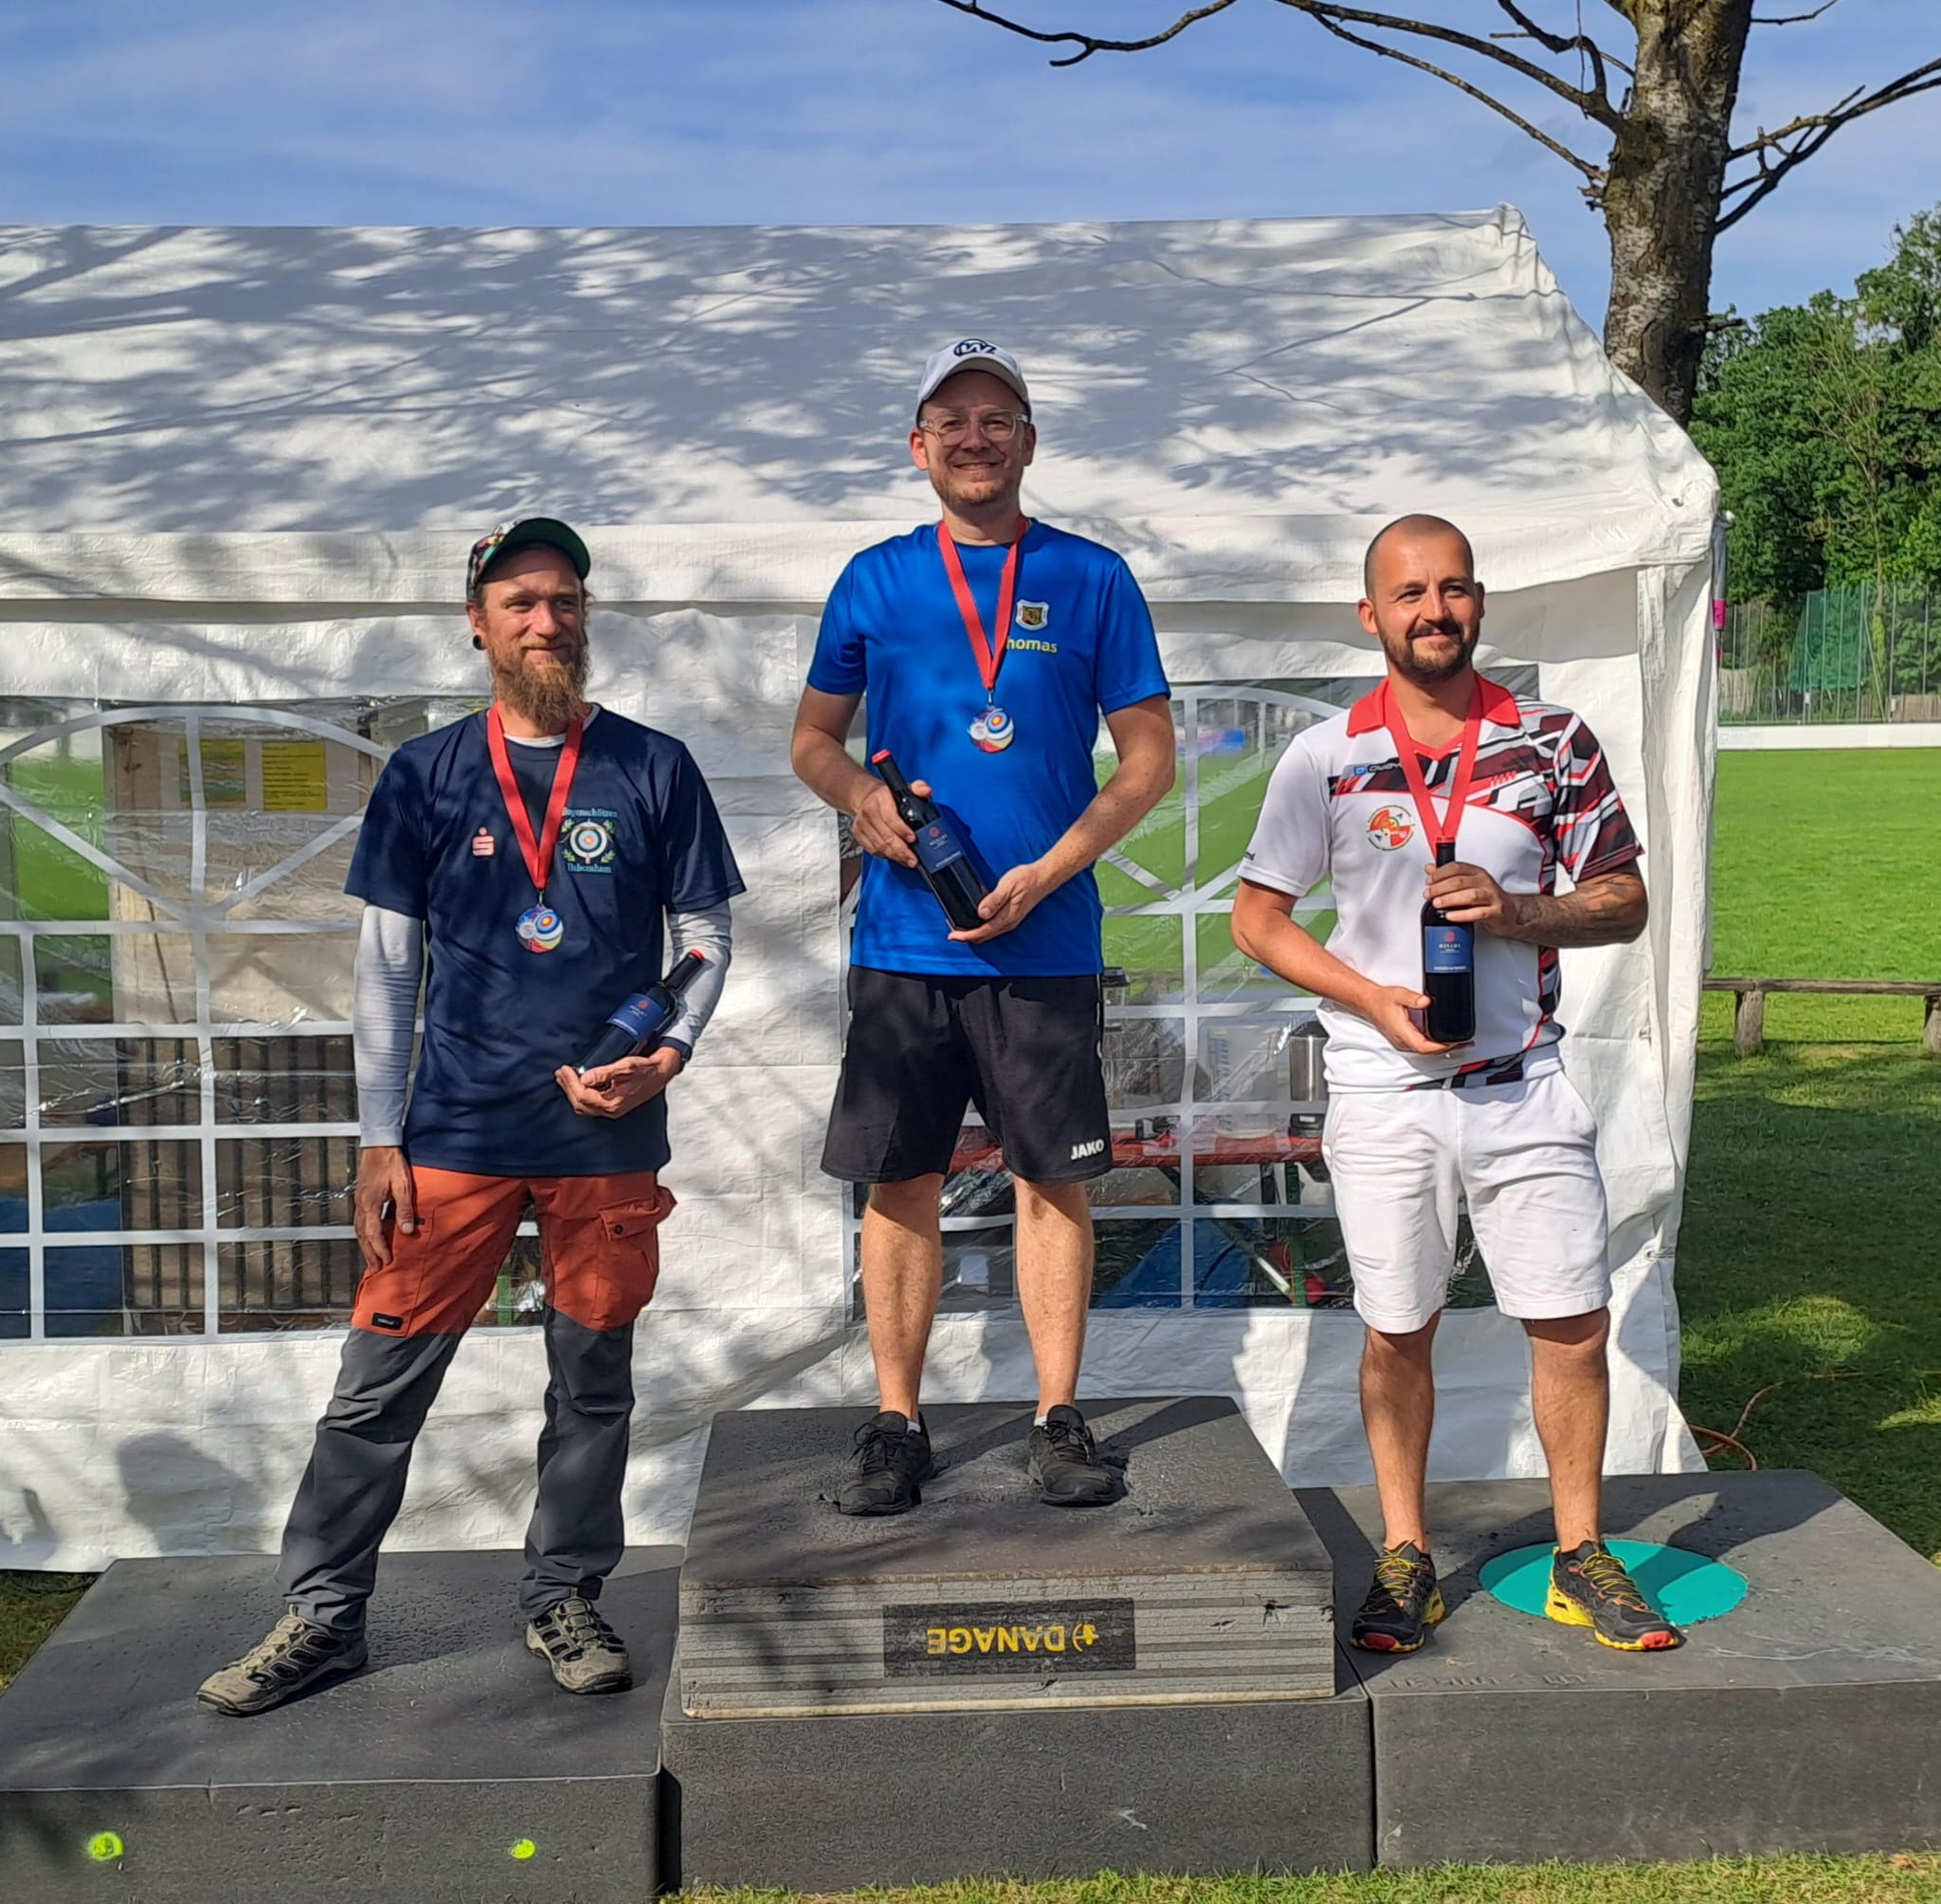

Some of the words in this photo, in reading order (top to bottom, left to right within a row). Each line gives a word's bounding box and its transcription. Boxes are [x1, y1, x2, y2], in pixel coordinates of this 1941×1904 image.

[1006, 636, 1058, 654] homas
[1070, 1138, 1105, 1160] JAKO
[926, 1624, 1066, 1655] DANAGE
